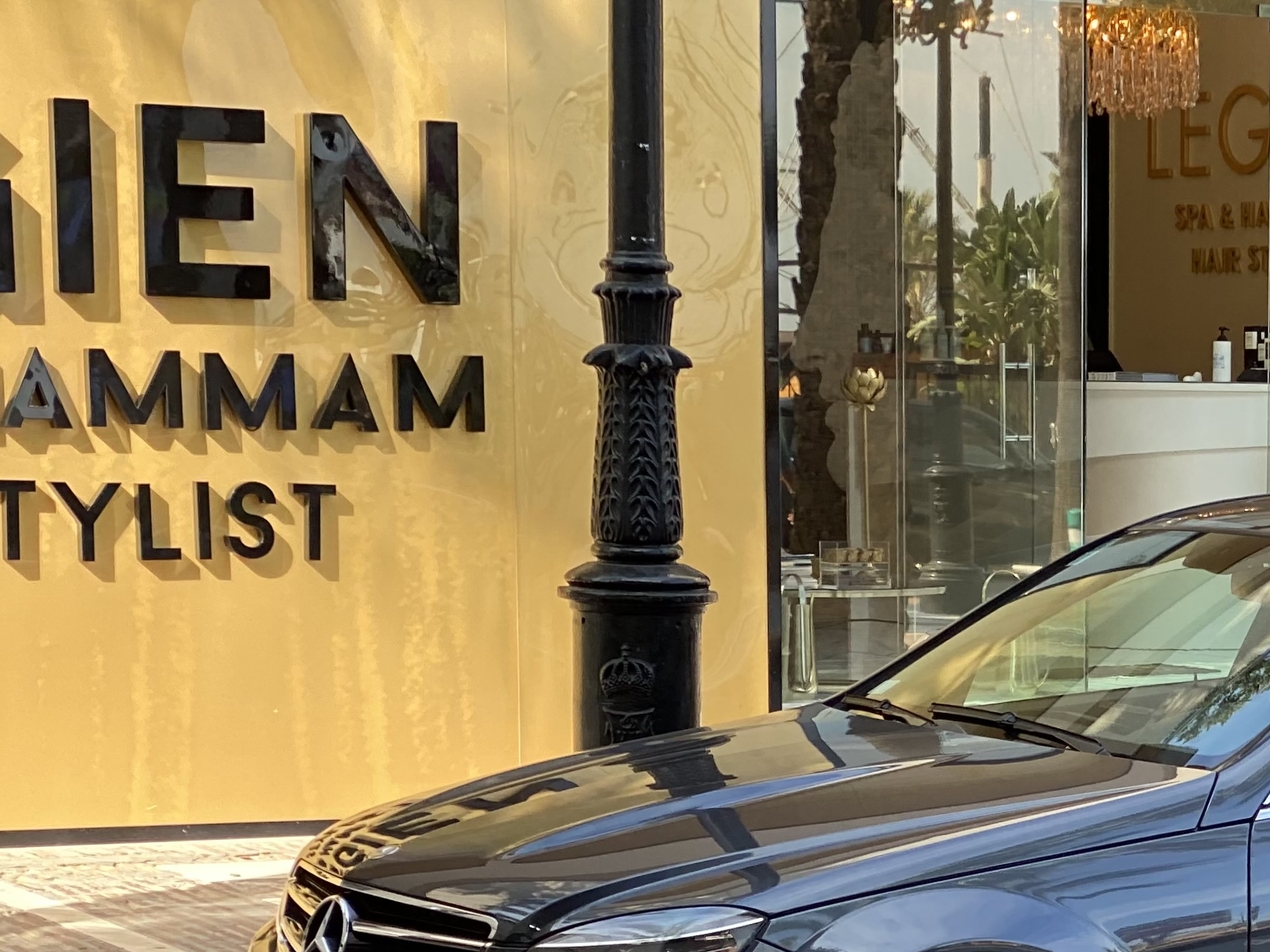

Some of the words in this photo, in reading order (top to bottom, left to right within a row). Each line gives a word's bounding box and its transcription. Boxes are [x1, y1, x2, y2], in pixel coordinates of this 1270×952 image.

[0, 97, 461, 305] IEN
[1174, 203, 1214, 231] SPA
[1219, 203, 1235, 230] &
[1191, 246, 1242, 274] HAIR
